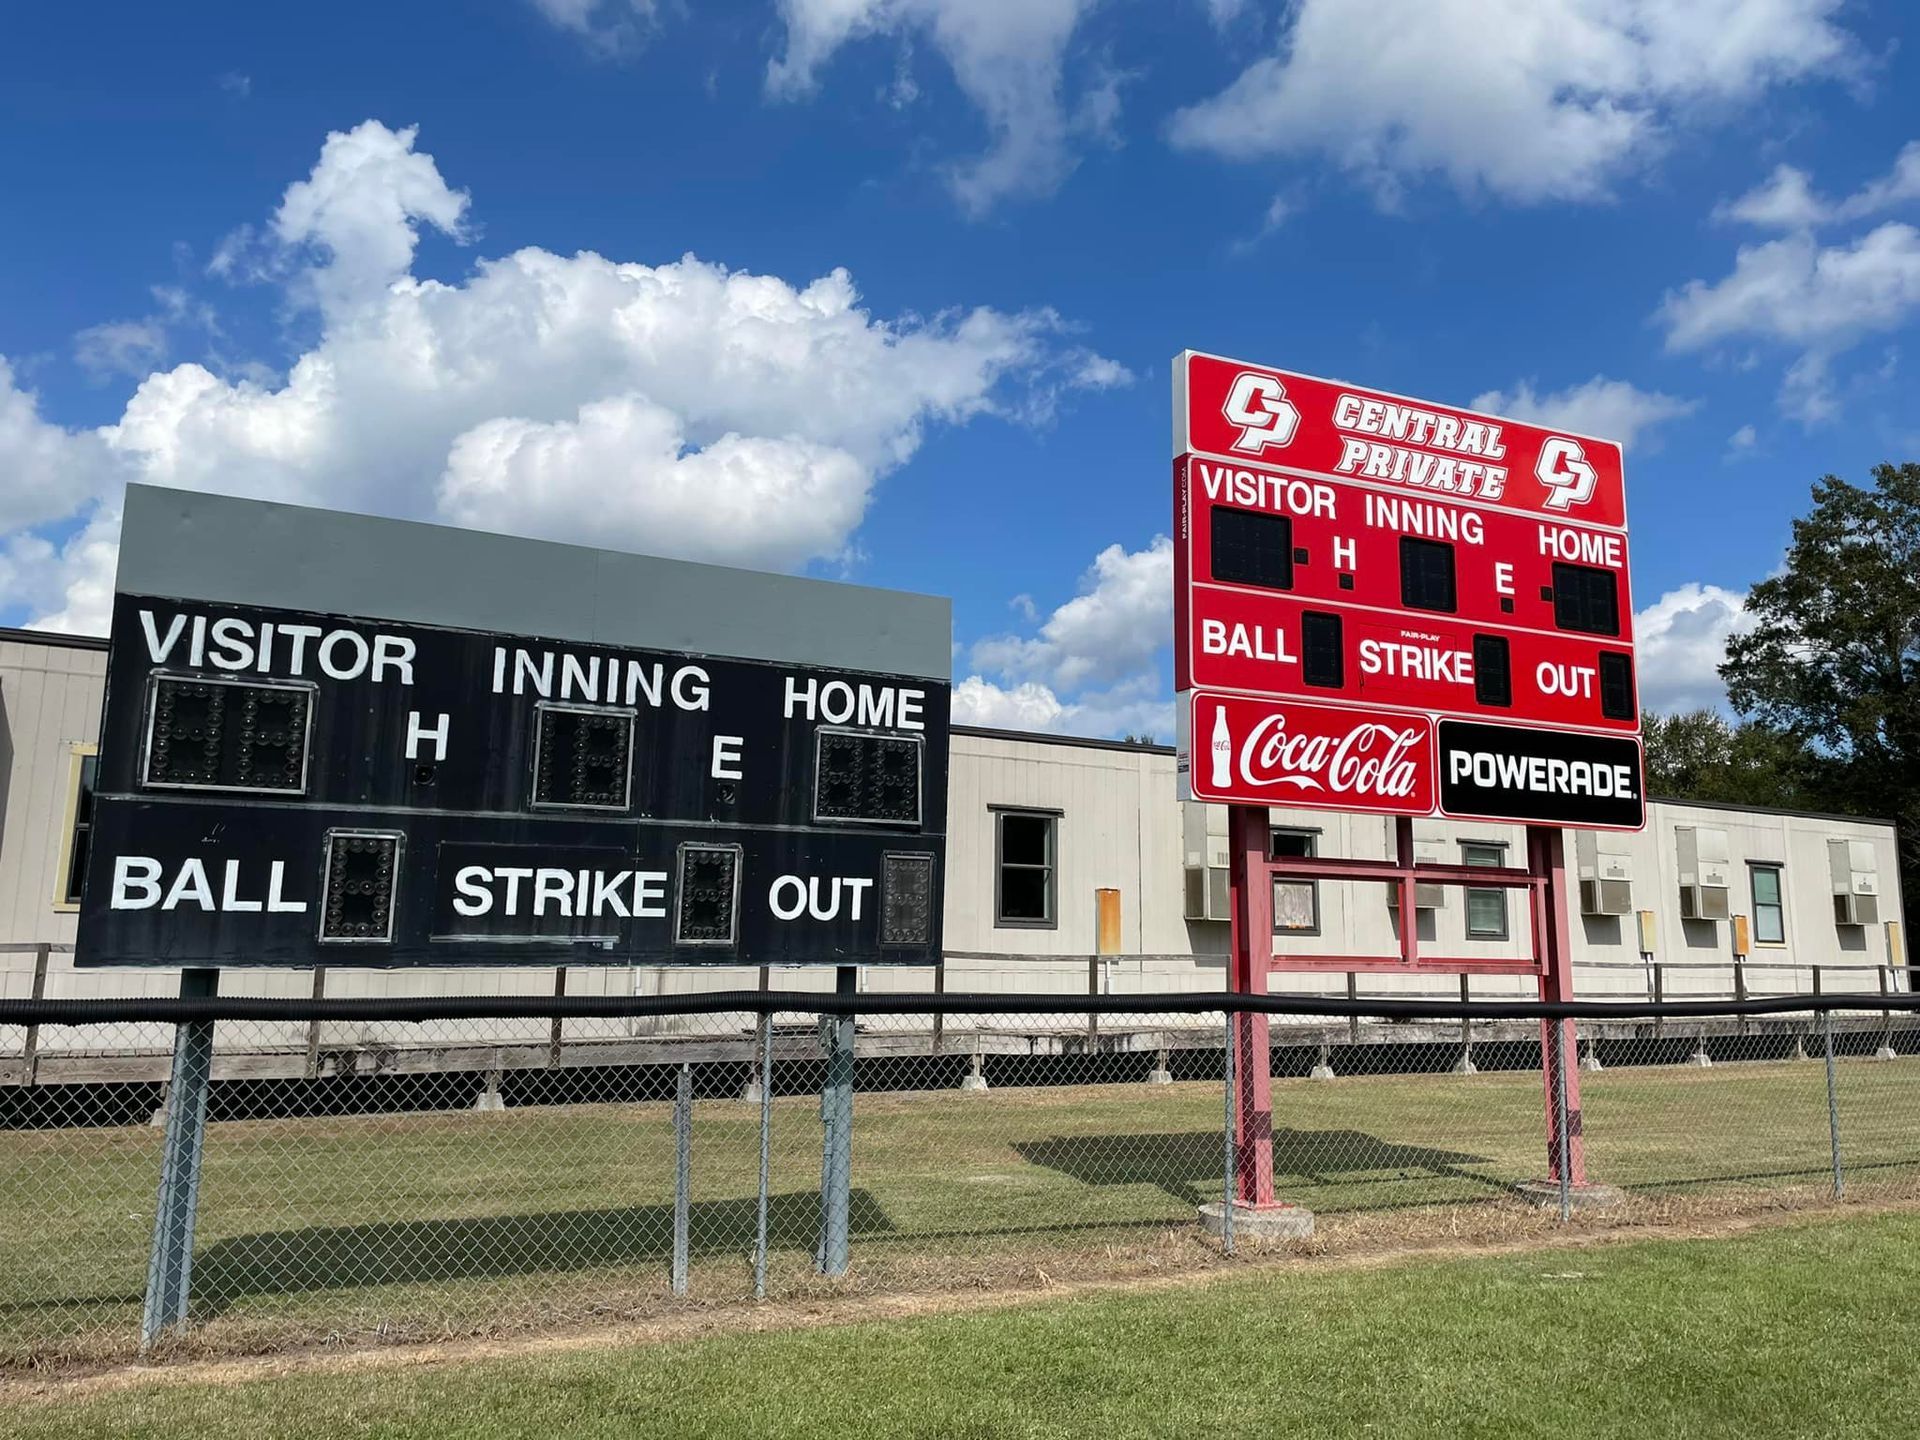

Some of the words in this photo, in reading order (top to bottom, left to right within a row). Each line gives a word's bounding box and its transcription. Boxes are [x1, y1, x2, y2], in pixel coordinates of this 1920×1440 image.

[1334, 394, 1506, 459] CENTRAL
[1200, 465, 1336, 520] VISITOR
[1334, 435, 1508, 501] PRIVATE
[1366, 494, 1486, 545] INNING
[1334, 536, 1355, 570] H
[1539, 525, 1623, 568] HOME
[1496, 563, 1514, 594] E
[139, 610, 416, 685] VISITOR
[1203, 620, 1297, 663] BALL
[1400, 630, 1440, 642] FAIR-PLAY
[492, 647, 710, 712] INNING
[1360, 638, 1474, 685] STRIKE
[1536, 662, 1596, 698] OUT
[784, 676, 925, 730] HOME
[406, 712, 449, 760] H
[712, 736, 743, 779] E
[1240, 713, 1427, 797] Coca-Cola
[1450, 749, 1632, 799] POWERADE
[111, 857, 306, 912] BALL
[453, 866, 667, 917] STRIKE
[769, 875, 872, 920] OUT
